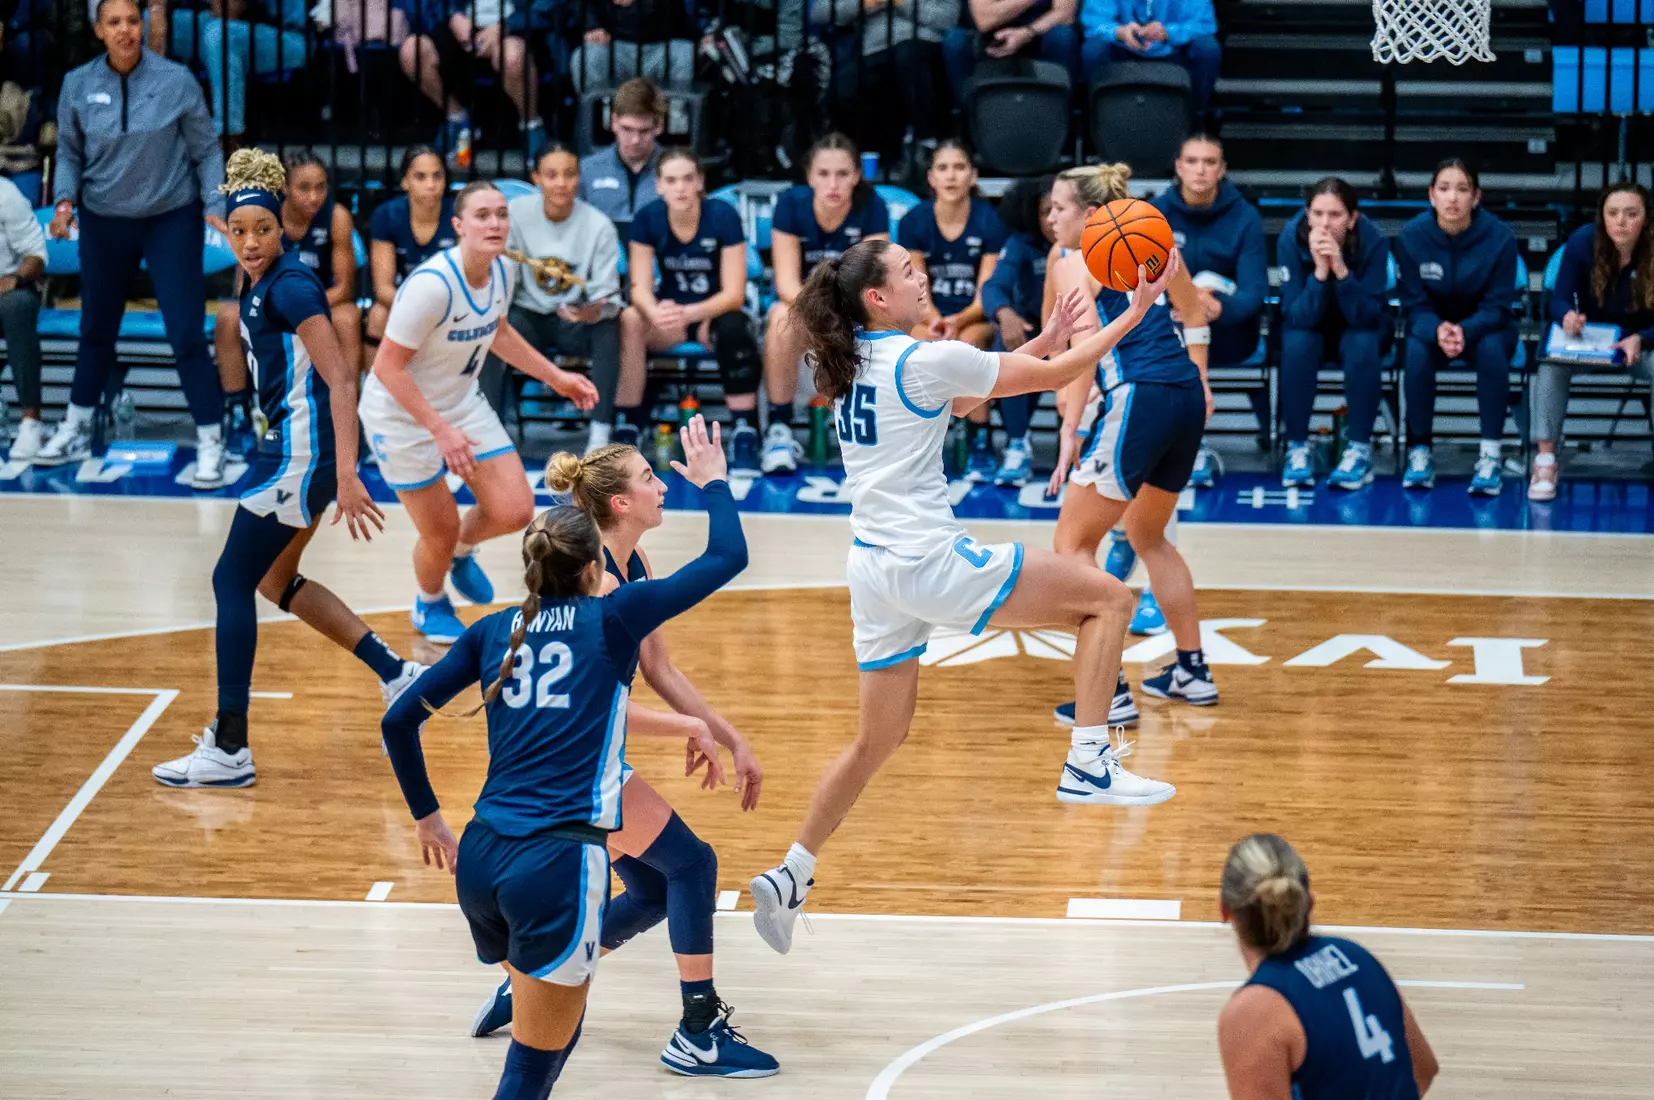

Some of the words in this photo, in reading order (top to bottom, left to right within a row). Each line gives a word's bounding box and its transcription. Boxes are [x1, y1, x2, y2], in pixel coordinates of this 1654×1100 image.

[460, 344, 481, 376] 4
[837, 382, 879, 447] 35
[953, 536, 994, 569] C
[502, 641, 575, 709] 32
[1343, 987, 1396, 1064] 4
